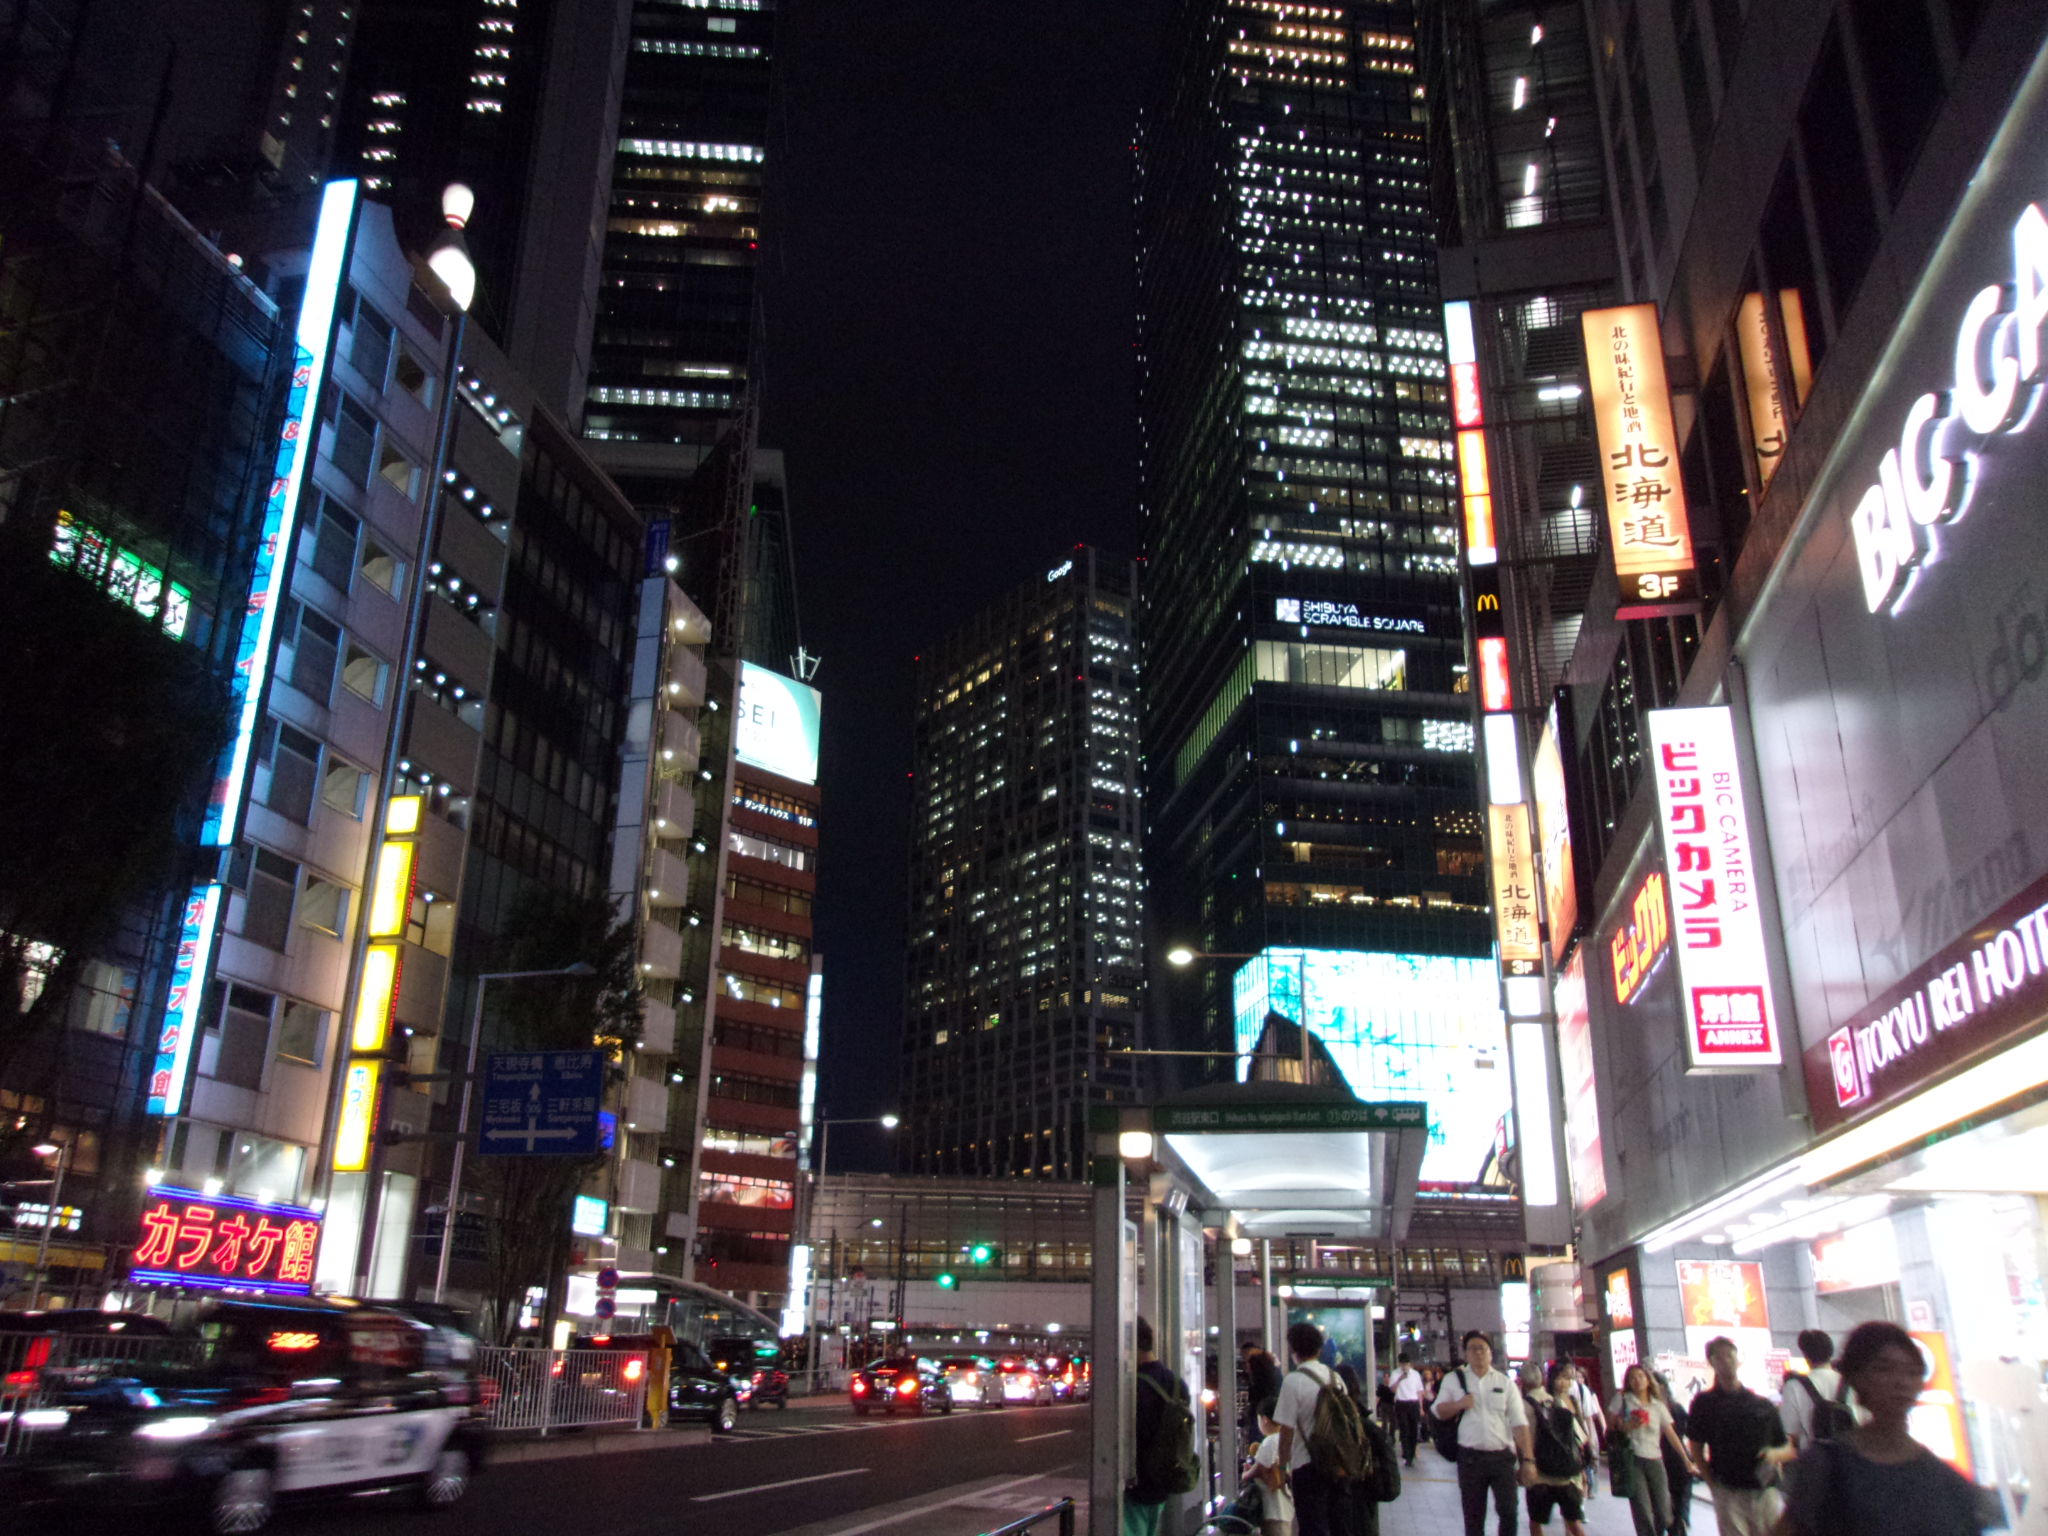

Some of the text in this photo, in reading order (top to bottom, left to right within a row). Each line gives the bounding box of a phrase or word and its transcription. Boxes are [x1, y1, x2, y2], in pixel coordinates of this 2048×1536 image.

[1612, 326, 1641, 433] 北の味紀行と地酒
[1610, 443, 1680, 546] 北海道
[1852, 393, 1952, 614] BIC
[1303, 600, 1358, 614] SHIBUYA
[1638, 574, 1678, 599] 3F
[1303, 613, 1425, 633] SCRAMBLE SQUARE
[799, 815, 814, 827] 11F
[1661, 742, 1722, 949] ビックカメラ
[1713, 772, 1749, 913] BIC CAMERA
[1502, 884, 1534, 945] 北海道
[1511, 959, 1534, 975] 3F
[1705, 1029, 1763, 1046] ANNEX
[1858, 991, 1928, 1074] TOKYU
[1928, 961, 1974, 1031] REI
[136, 1203, 318, 1281] カラオケ館
